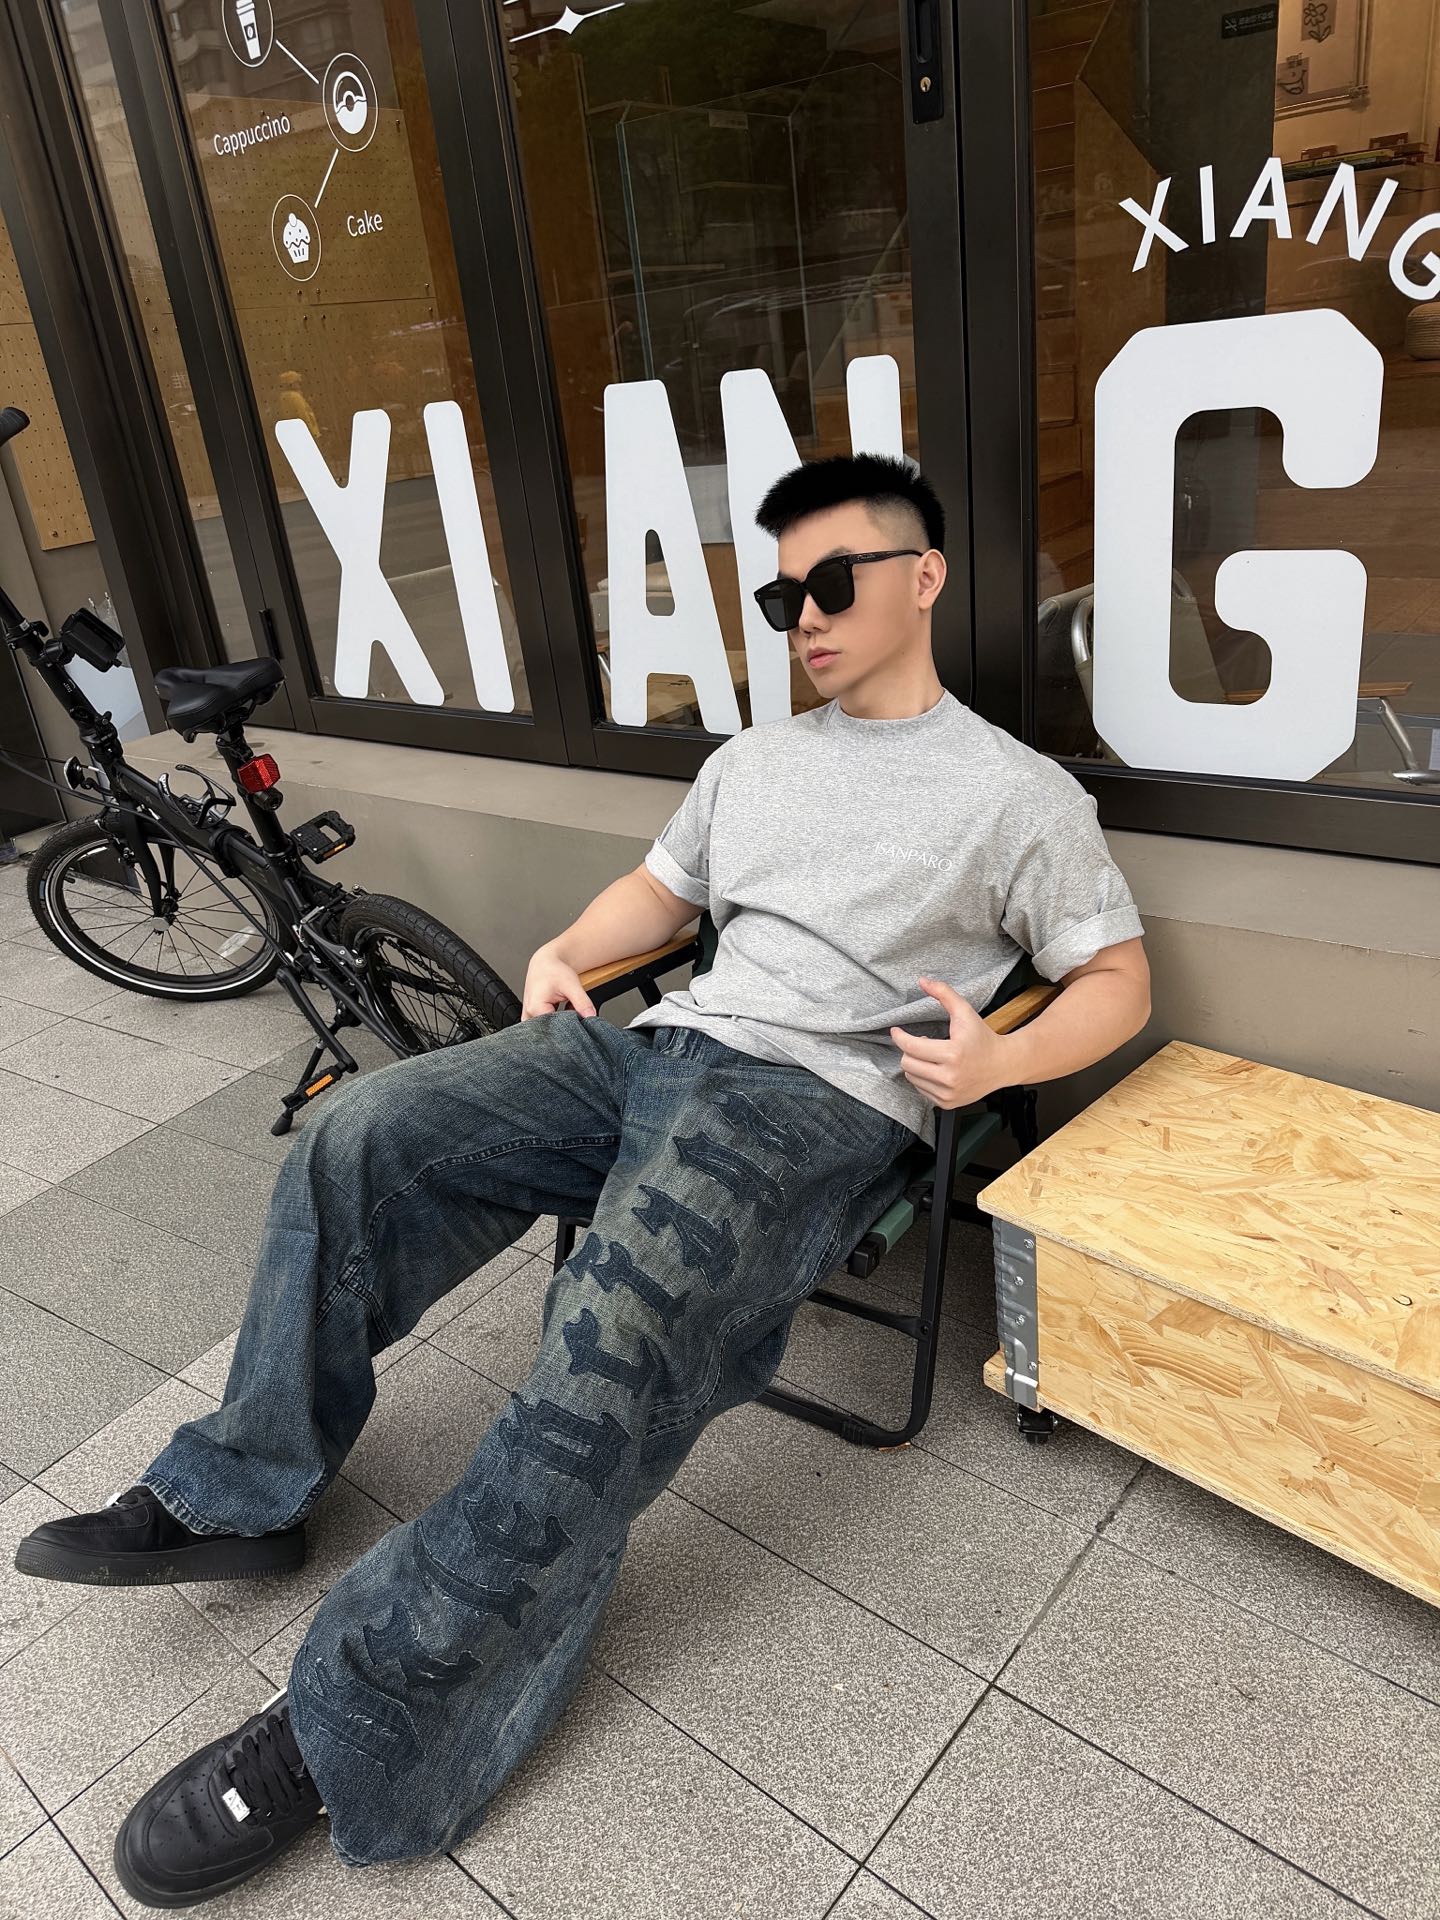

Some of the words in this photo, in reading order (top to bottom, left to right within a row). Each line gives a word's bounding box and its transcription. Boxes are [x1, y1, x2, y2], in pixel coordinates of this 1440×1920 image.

[213, 116, 291, 157] Cappuccino
[346, 210, 383, 237] Cake
[1118, 157, 1440, 300] XIANG
[874, 841, 953, 872] ISANPARO
